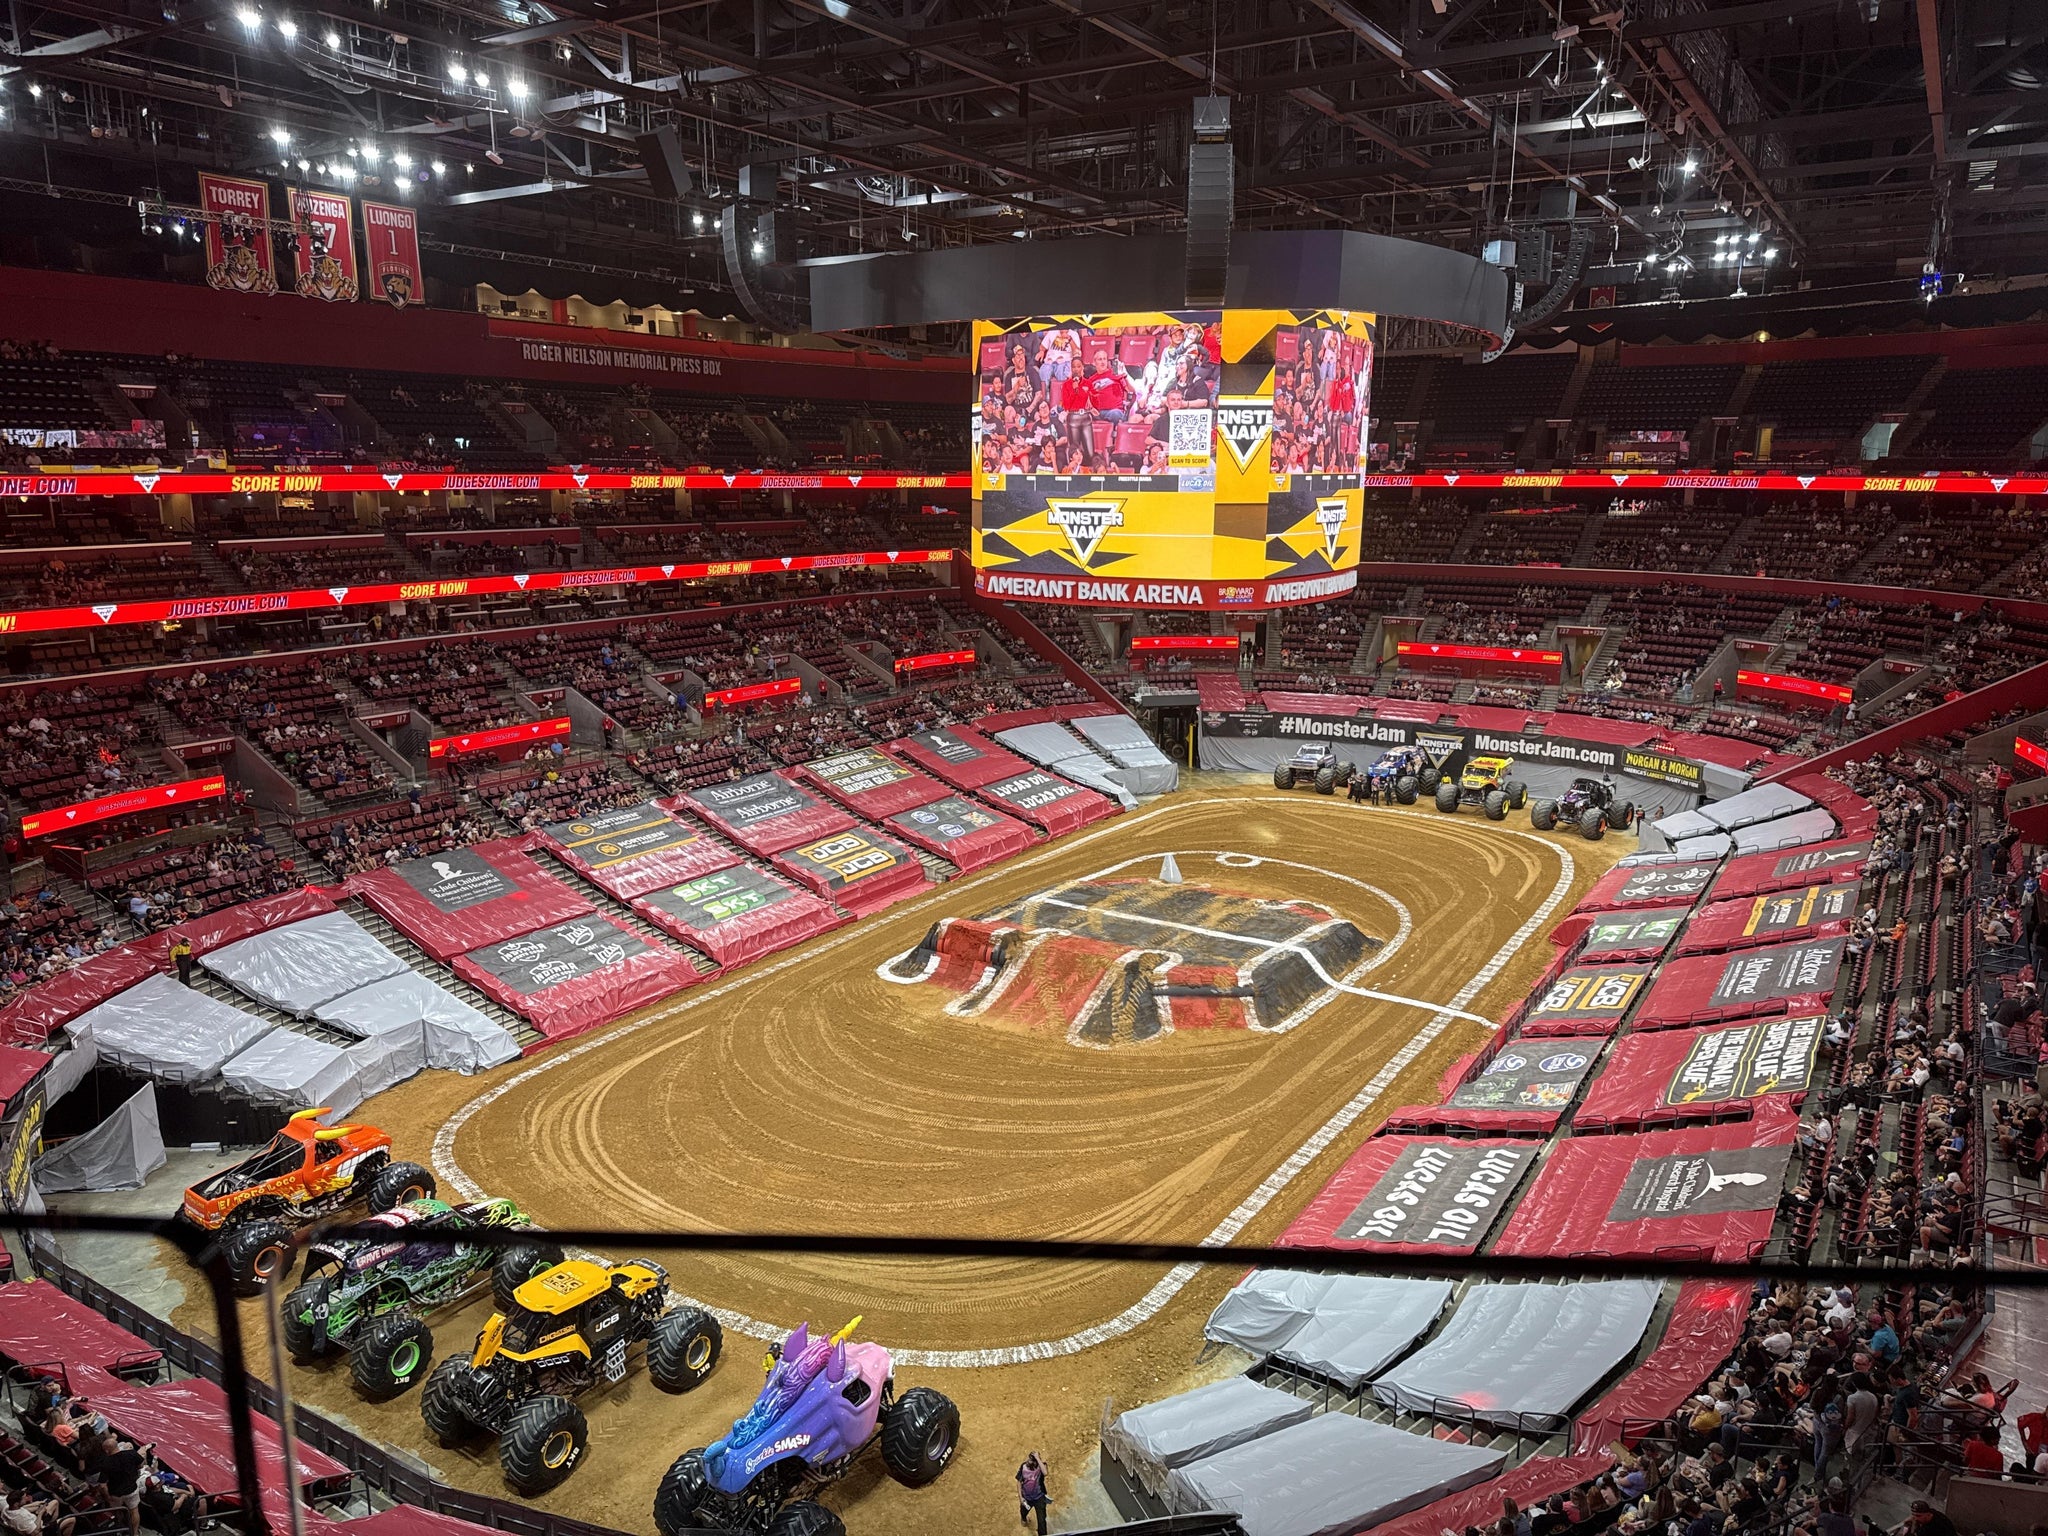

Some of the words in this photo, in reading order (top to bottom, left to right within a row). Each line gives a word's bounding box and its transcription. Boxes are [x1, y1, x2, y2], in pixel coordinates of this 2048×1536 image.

[209, 185, 260, 210] TORREY
[369, 208, 413, 229] LUONGO
[311, 221, 337, 249] 7
[388, 229, 399, 256] 1
[522, 343, 562, 363] ROGER
[564, 347, 612, 367] NEILSON
[613, 352, 669, 371] MEMORIAL
[670, 357, 701, 374] PRESS
[702, 359, 722, 376] BOX
[1224, 425, 1265, 441] JAM
[1171, 457, 1184, 465] SCAN
[1185, 457, 1190, 465] TO
[1191, 457, 1208, 465] SCORE
[231, 476, 282, 493] SCORE
[284, 475, 322, 492] NOW!
[441, 475, 540, 489] JUDGESZONE.COM
[630, 475, 662, 489] SCORE
[662, 475, 686, 489] NOW!
[759, 476, 823, 489] JUDGESZONE.COM
[895, 476, 922, 489] SCORE
[923, 476, 947, 488] NOW!
[1180, 478, 1202, 488] LUCAS
[1202, 478, 1213, 488] OIL
[1661, 476, 1760, 489] JUDGESZONE.COM
[1863, 478, 1902, 491] SCORE
[1903, 479, 1937, 492] NOW!
[1047, 510, 1124, 527] MONSTER
[1316, 508, 1348, 525] MONSTER
[1067, 524, 1101, 539] JAM
[1324, 522, 1341, 536] JAM
[810, 554, 865, 567] JUDGESZONE.COM
[928, 550, 951, 561] SCORE
[558, 570, 636, 586] JUDGESZONE.COM
[706, 563, 732, 576] SCORE
[733, 562, 752, 574] NOW!
[400, 583, 436, 599] SCORE
[438, 581, 468, 596] NOW!
[987, 575, 1077, 599] AMERANT
[1078, 581, 1130, 603] BANK
[1133, 584, 1204, 606] ARENA
[1264, 579, 1325, 604] AMERANT
[166, 594, 289, 617] JUDGESZONE.COM
[1278, 715, 1406, 744] #MonsterJam
[218, 742, 233, 752] 116
[1415, 737, 1463, 751] MONSTER
[1427, 745, 1452, 757] JAM
[1474, 733, 1616, 766] MonsterJam.com
[807, 760, 831, 771] THE
[827, 751, 870, 768] ORIGINAL
[817, 764, 850, 778] SUPER
[847, 758, 874, 771] GLUE
[1625, 752, 1661, 770] MORGAN
[1660, 759, 1667, 772] &
[1668, 761, 1699, 780] MORGAN
[831, 775, 854, 787] THE
[851, 767, 894, 782] ORIGINAL
[1623, 766, 1647, 777] AMERICA'S
[202, 782, 222, 792] SCORE
[710, 779, 772, 801] Airborne
[842, 780, 875, 793] SUPER
[871, 773, 898, 786] GLUE
[991, 777, 1032, 798] LUCAS
[1031, 772, 1050, 786] OIL
[735, 795, 797, 819] Airborne
[1016, 790, 1057, 810] LUCAS
[1056, 784, 1075, 798] OIL
[590, 811, 640, 828] NORTHERN
[617, 830, 667, 847] NORTHERN
[812, 837, 861, 860] JCB
[841, 851, 889, 874] JCB
[428, 887, 440, 895] St.
[439, 882, 458, 893] Jude
[456, 871, 495, 887] Children's
[467, 876, 501, 890] Hospital
[551, 925, 568, 933] VISIT
[500, 942, 548, 963] INDIANA
[582, 943, 599, 952] VISIT
[531, 961, 579, 985] INDIANA
[1734, 957, 1774, 995] Airborne
[1795, 948, 1834, 986] Airborne
[1537, 982, 1577, 1012] JCB
[1589, 975, 1630, 1007] JCB
[1724, 1028, 1750, 1046] THE
[1761, 1021, 1793, 1052] SUPER
[1791, 1018, 1818, 1037] THE
[1694, 1030, 1727, 1061] SUPER
[1682, 1060, 1713, 1084] GLUE
[1753, 1050, 1782, 1079] GLUE
[1667, 1160, 1689, 1188] Research
[1687, 1166, 1702, 1181] Jude
[1691, 1158, 1704, 1170] St.
[1385, 1147, 1454, 1206] LUCAS
[1453, 1148, 1522, 1208] LUCAS
[1654, 1186, 1679, 1212] Hospital
[1672, 1179, 1697, 1211] Children's
[1355, 1205, 1407, 1238] OIL
[1429, 1207, 1479, 1240] OIL
[273, 1239, 290, 1251] BKT
[356, 1249, 381, 1269] GRAVE
[251, 1275, 268, 1285] BKT
[595, 1313, 620, 1333] JCB
[489, 1324, 503, 1343] JCB
[539, 1323, 577, 1344] DIGATRON
[393, 1376, 410, 1385] BKT
[696, 1363, 711, 1378] BKT
[565, 1446, 580, 1469] BKT
[744, 1446, 775, 1475] Sparkle
[773, 1433, 812, 1455] SMASH
[939, 1445, 953, 1468] BKT
